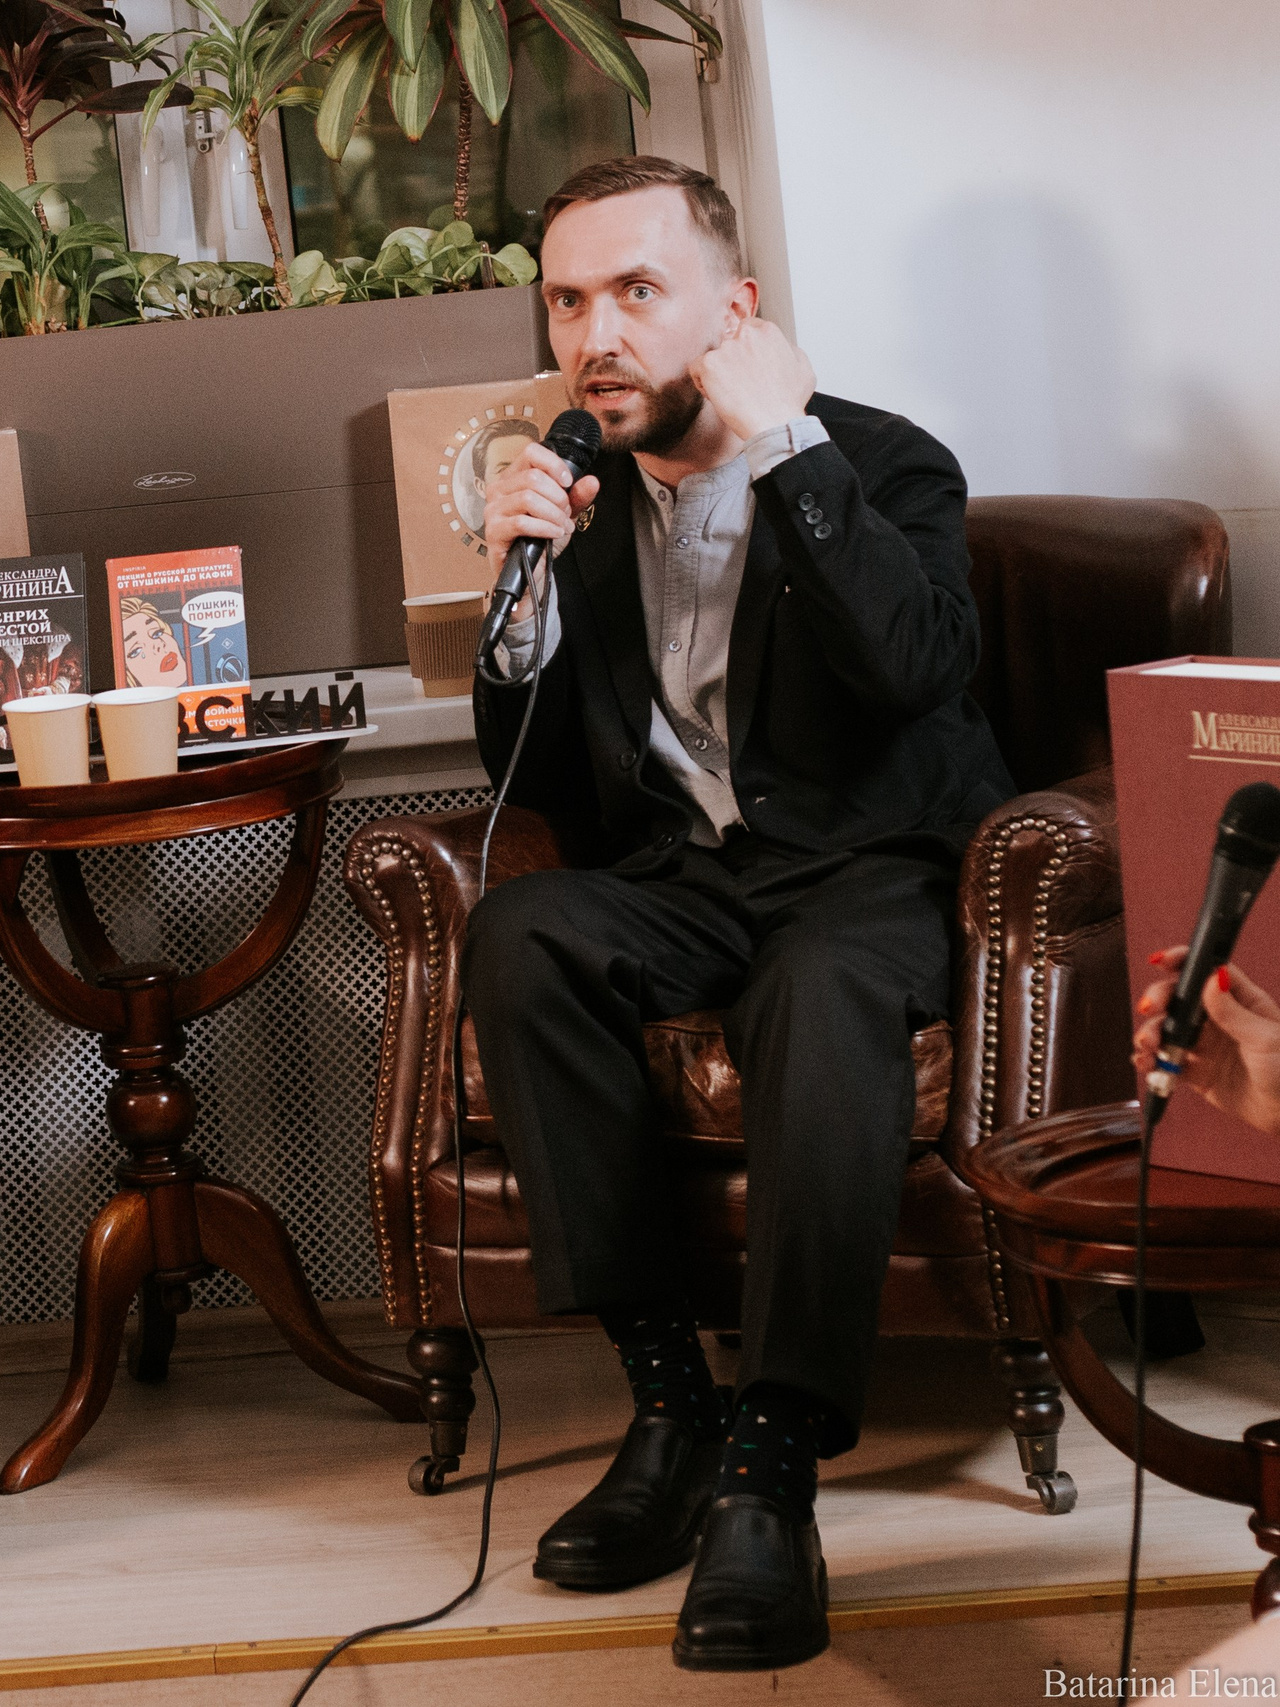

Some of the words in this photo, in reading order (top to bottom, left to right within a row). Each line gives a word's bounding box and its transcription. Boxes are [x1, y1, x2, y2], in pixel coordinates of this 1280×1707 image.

[116, 573, 146, 581] ЛЕКЦИИ
[153, 568, 186, 578] РУССКОЙ
[186, 563, 234, 573] ЛИТЕРАТУРЕ:
[117, 581, 130, 590] ОТ
[132, 577, 181, 587] ПУШКИНА
[183, 573, 197, 583] ДО
[199, 569, 233, 580] КАФКИ
[187, 599, 239, 612] ПУШКИН,
[188, 609, 237, 622] ПОМОГИ
[12, 633, 72, 647] ШЕКСПИРА
[204, 703, 244, 717] ВОЙНЫЕ
[194, 716, 246, 729] СТОЧКИ
